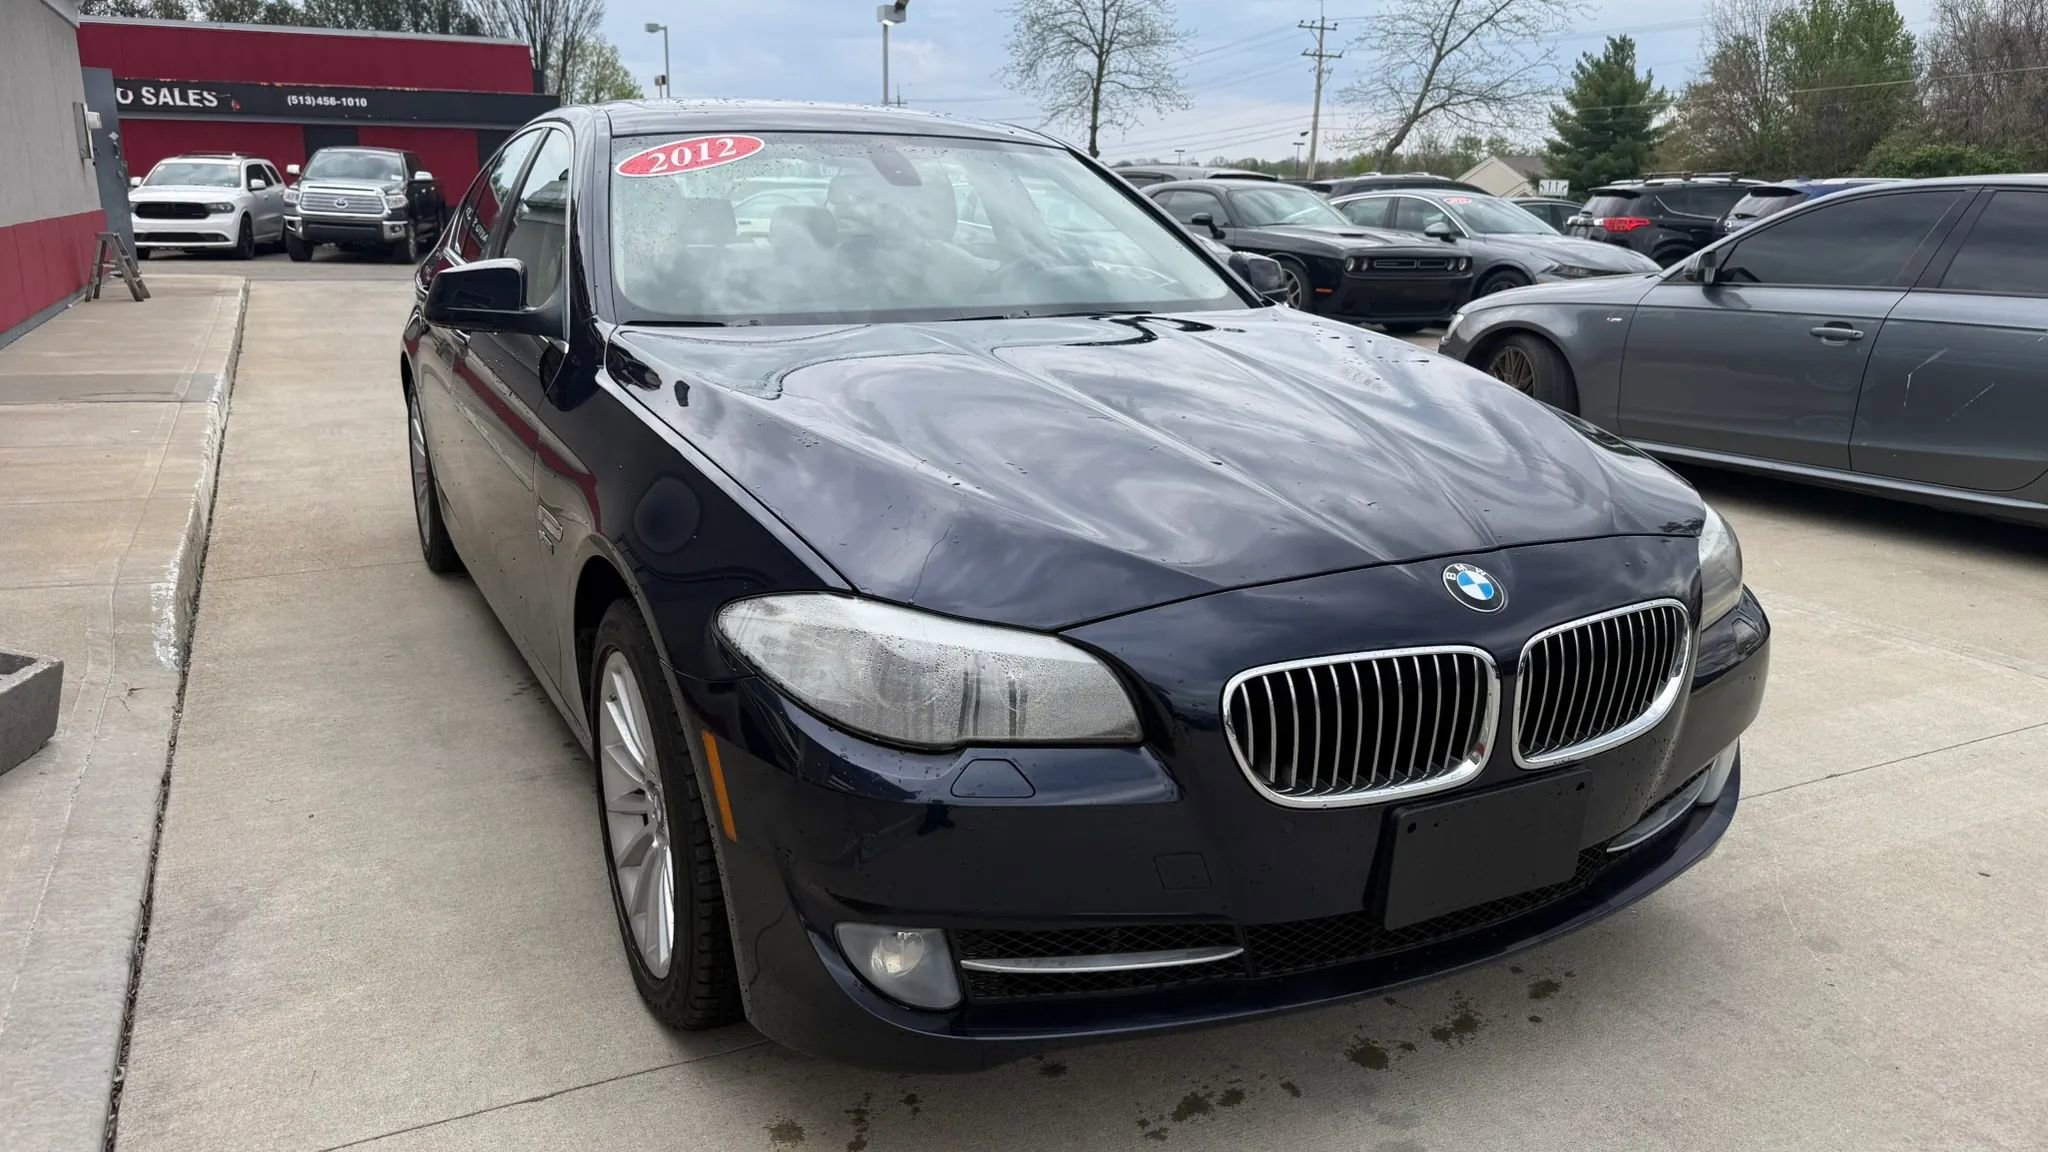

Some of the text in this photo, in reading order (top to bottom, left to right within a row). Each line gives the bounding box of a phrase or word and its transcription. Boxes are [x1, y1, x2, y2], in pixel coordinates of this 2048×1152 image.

[141, 86, 218, 107] SALES
[647, 138, 737, 173] 2012
[1445, 563, 1487, 581] BMW
